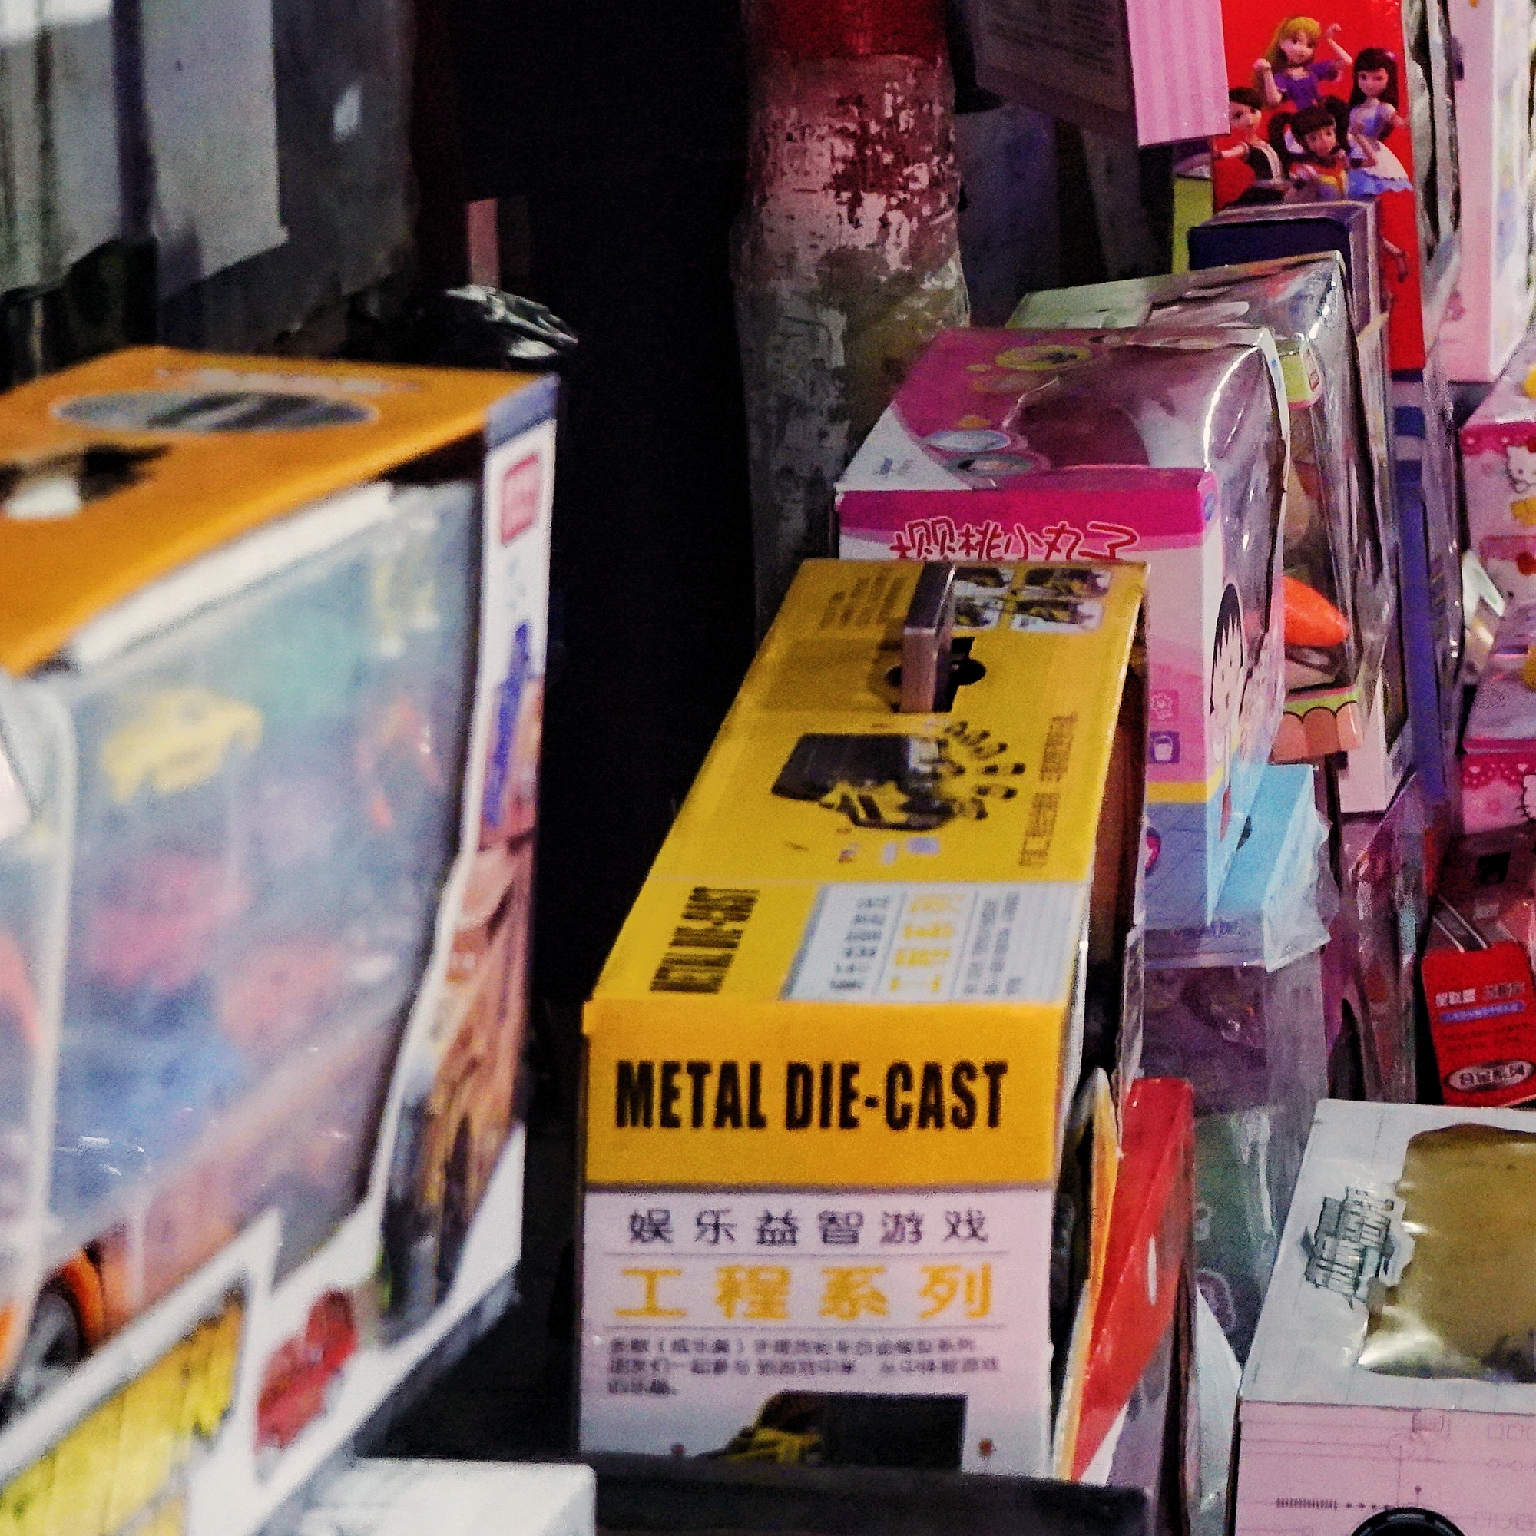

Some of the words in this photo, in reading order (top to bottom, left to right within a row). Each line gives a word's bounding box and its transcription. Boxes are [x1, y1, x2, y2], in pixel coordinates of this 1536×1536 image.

[615, 1060, 767, 1130] METAL
[784, 1060, 1010, 1131] DIE-CAST
[629, 1208, 989, 1246] 娱乐益智游戏
[614, 1263, 992, 1321] 工程系列
